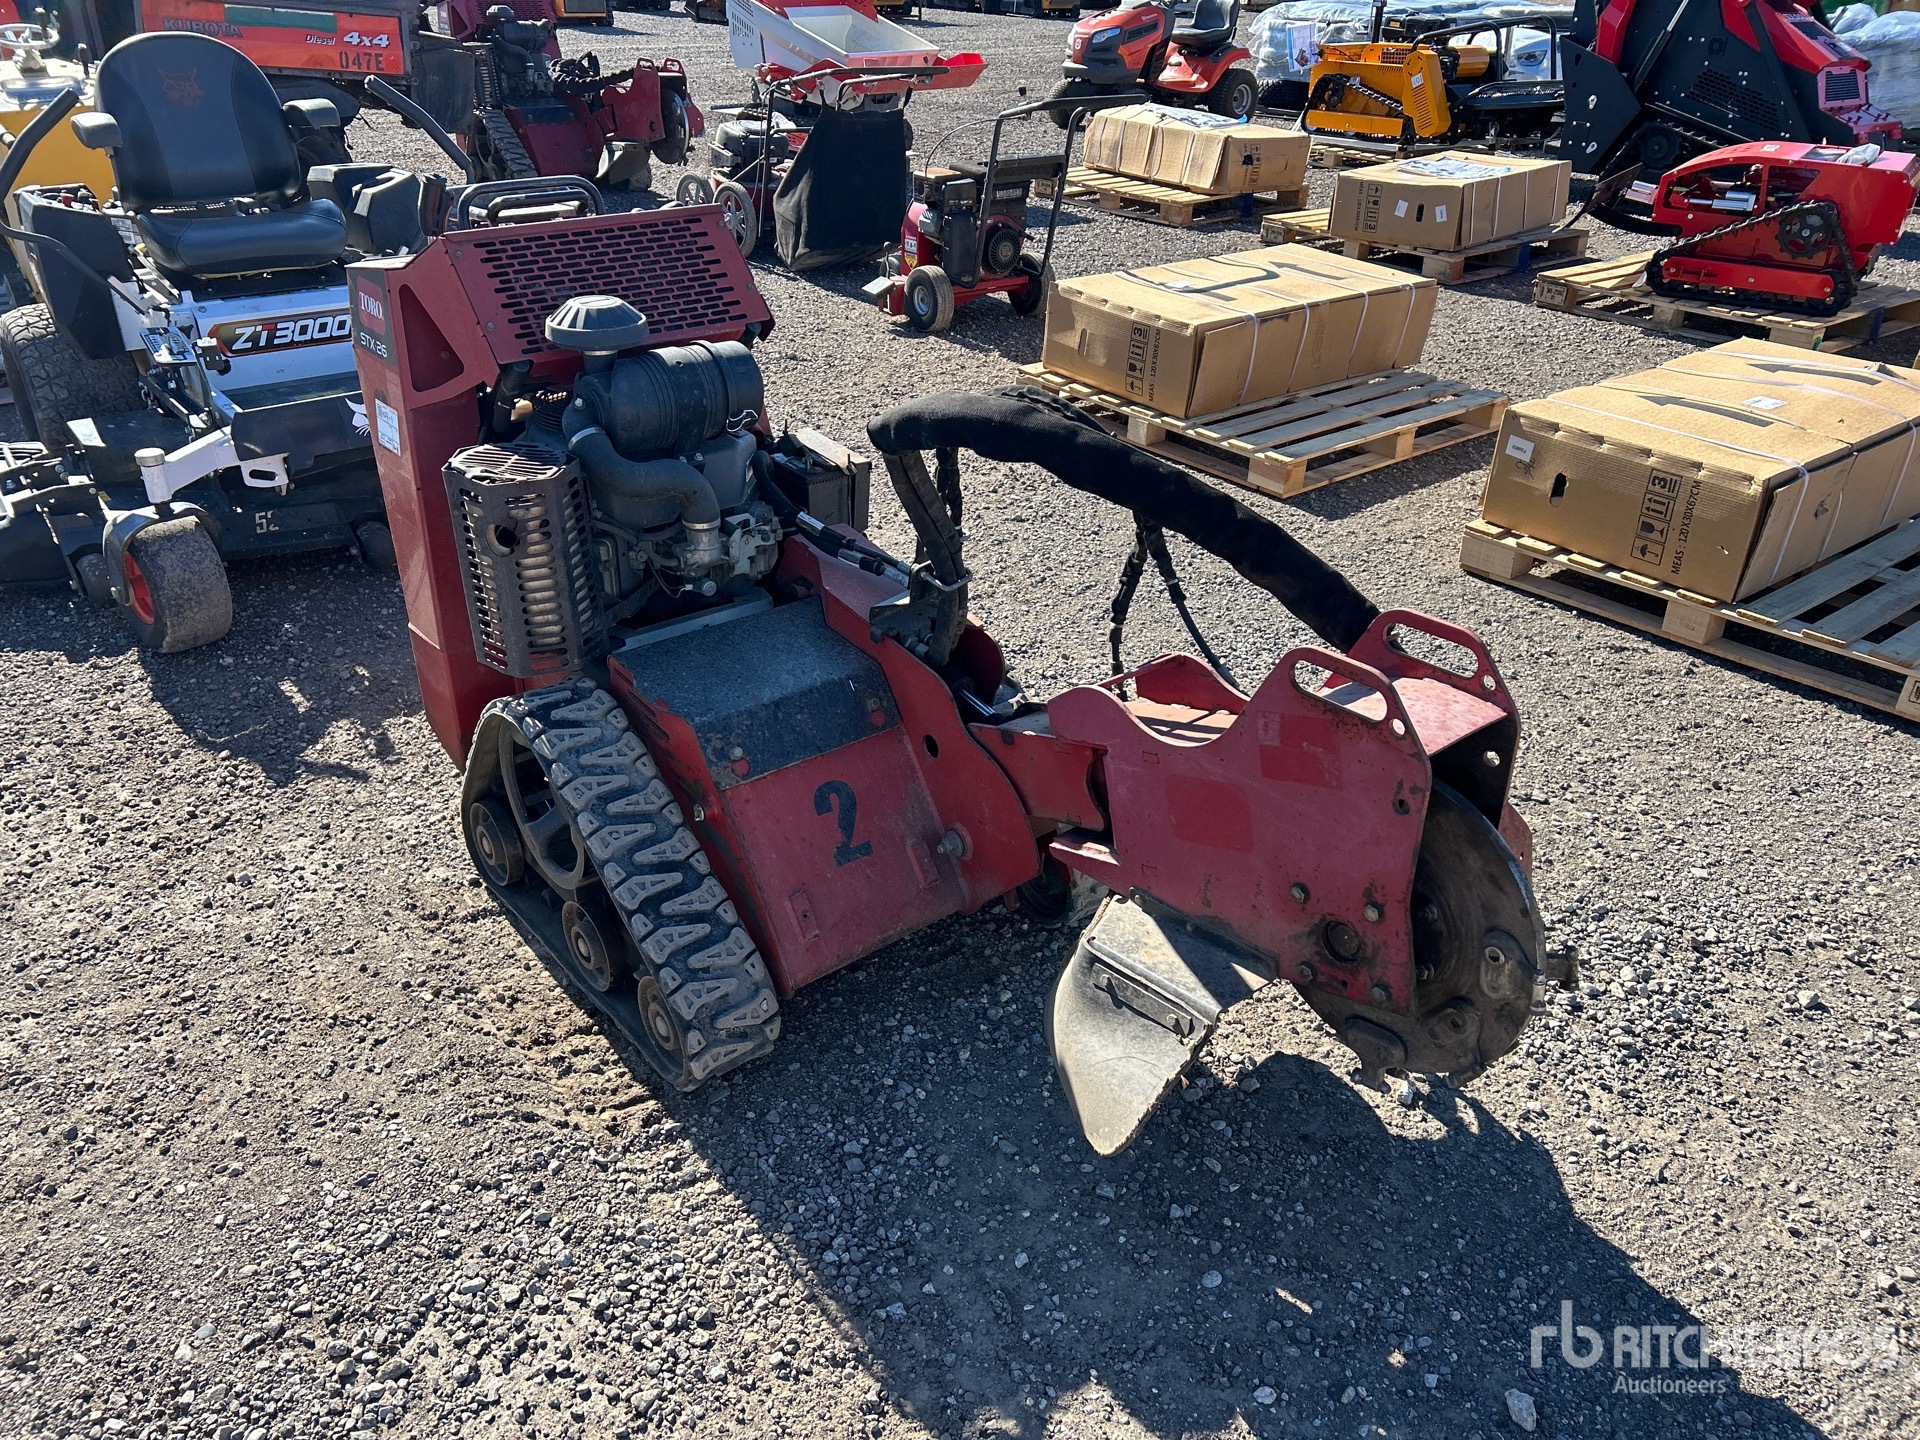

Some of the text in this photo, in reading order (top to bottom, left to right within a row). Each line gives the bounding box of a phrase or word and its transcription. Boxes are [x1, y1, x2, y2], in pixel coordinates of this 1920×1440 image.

[163, 18, 243, 38] KUBOTA
[305, 31, 390, 48] Diesel 4x4
[338, 50, 385, 72] 047E
[358, 291, 385, 320] TORO
[231, 314, 351, 351] ZT3000
[813, 779, 873, 867] 2
